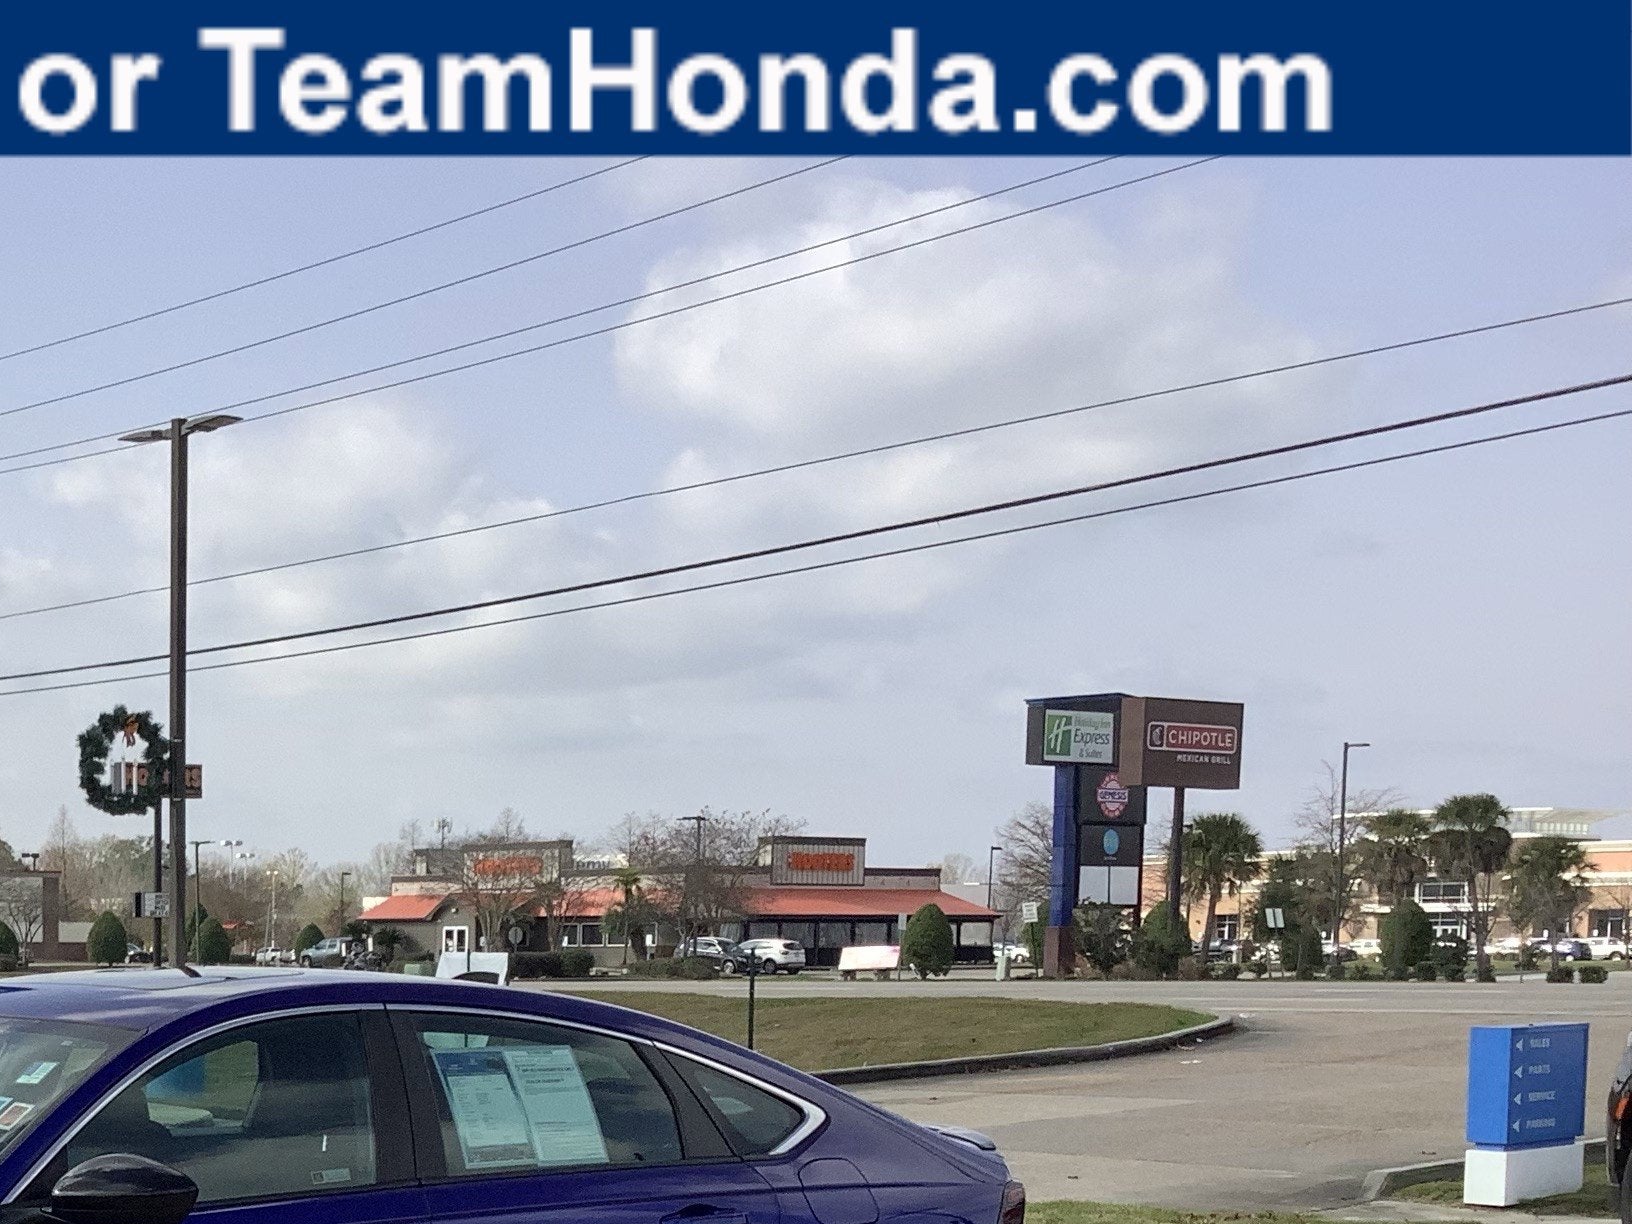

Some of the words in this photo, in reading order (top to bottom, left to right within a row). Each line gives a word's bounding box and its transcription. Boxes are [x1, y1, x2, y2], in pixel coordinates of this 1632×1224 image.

[1073, 728, 1111, 746] Express
[1168, 729, 1234, 748] CHIPOTLE
[1176, 754, 1210, 763] MEXICAN
[1210, 755, 1232, 765] GRILL
